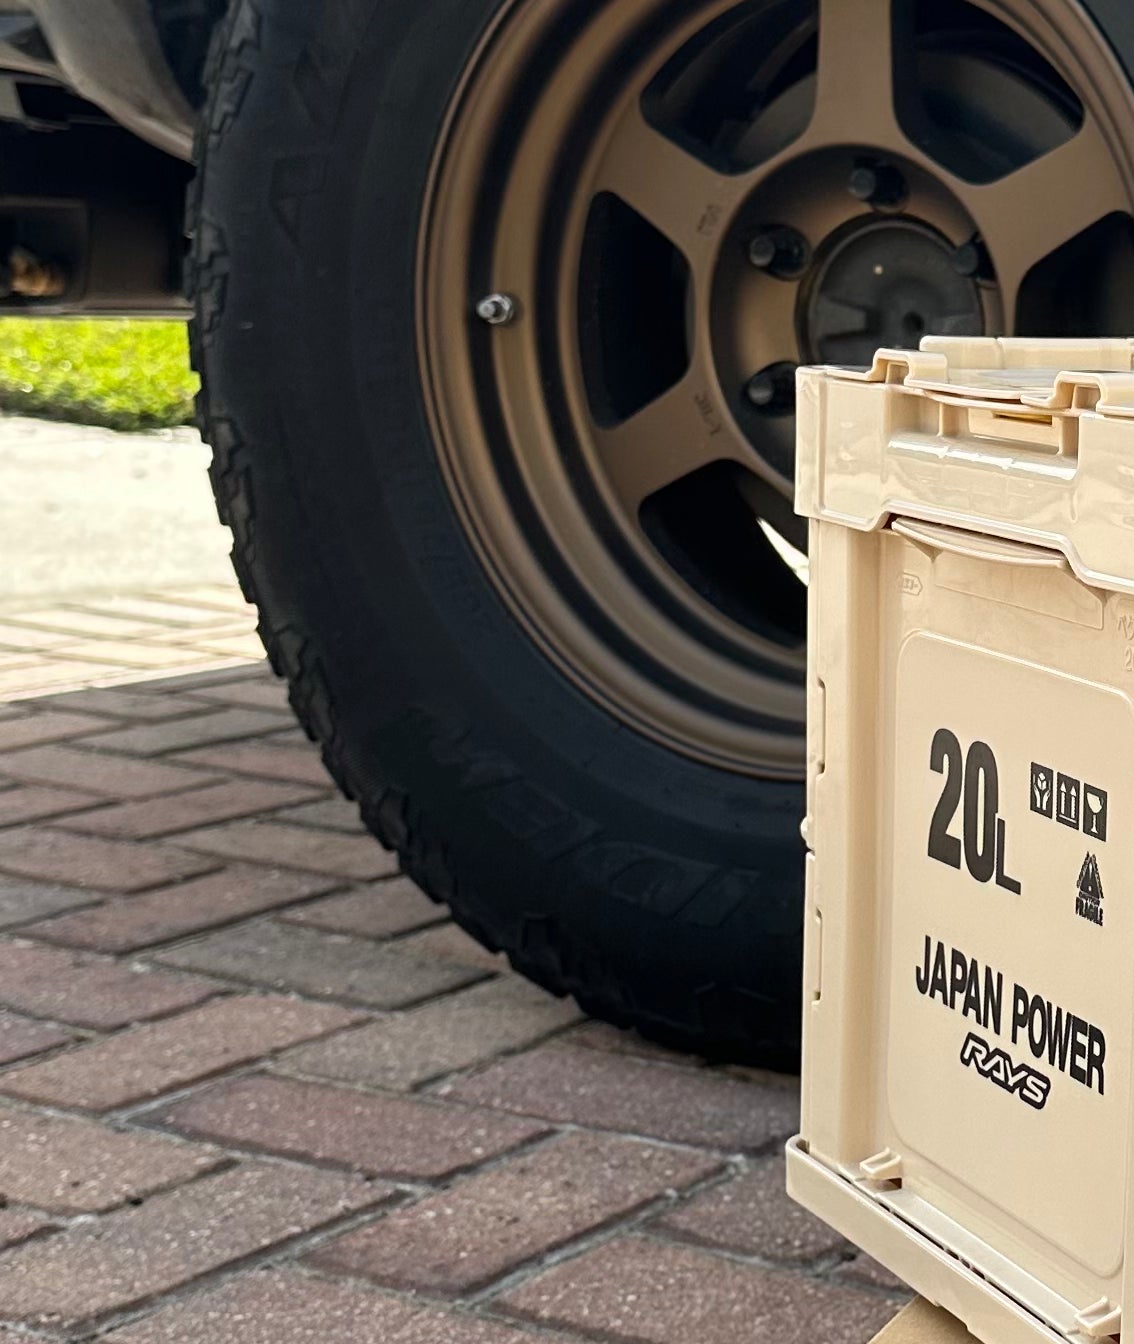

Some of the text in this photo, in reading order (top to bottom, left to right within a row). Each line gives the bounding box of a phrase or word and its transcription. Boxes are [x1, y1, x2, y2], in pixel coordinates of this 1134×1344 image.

[927, 728, 1021, 895] 20L
[915, 934, 1105, 1095] JAPAN POWER
[960, 1032, 1051, 1110] RAYS
